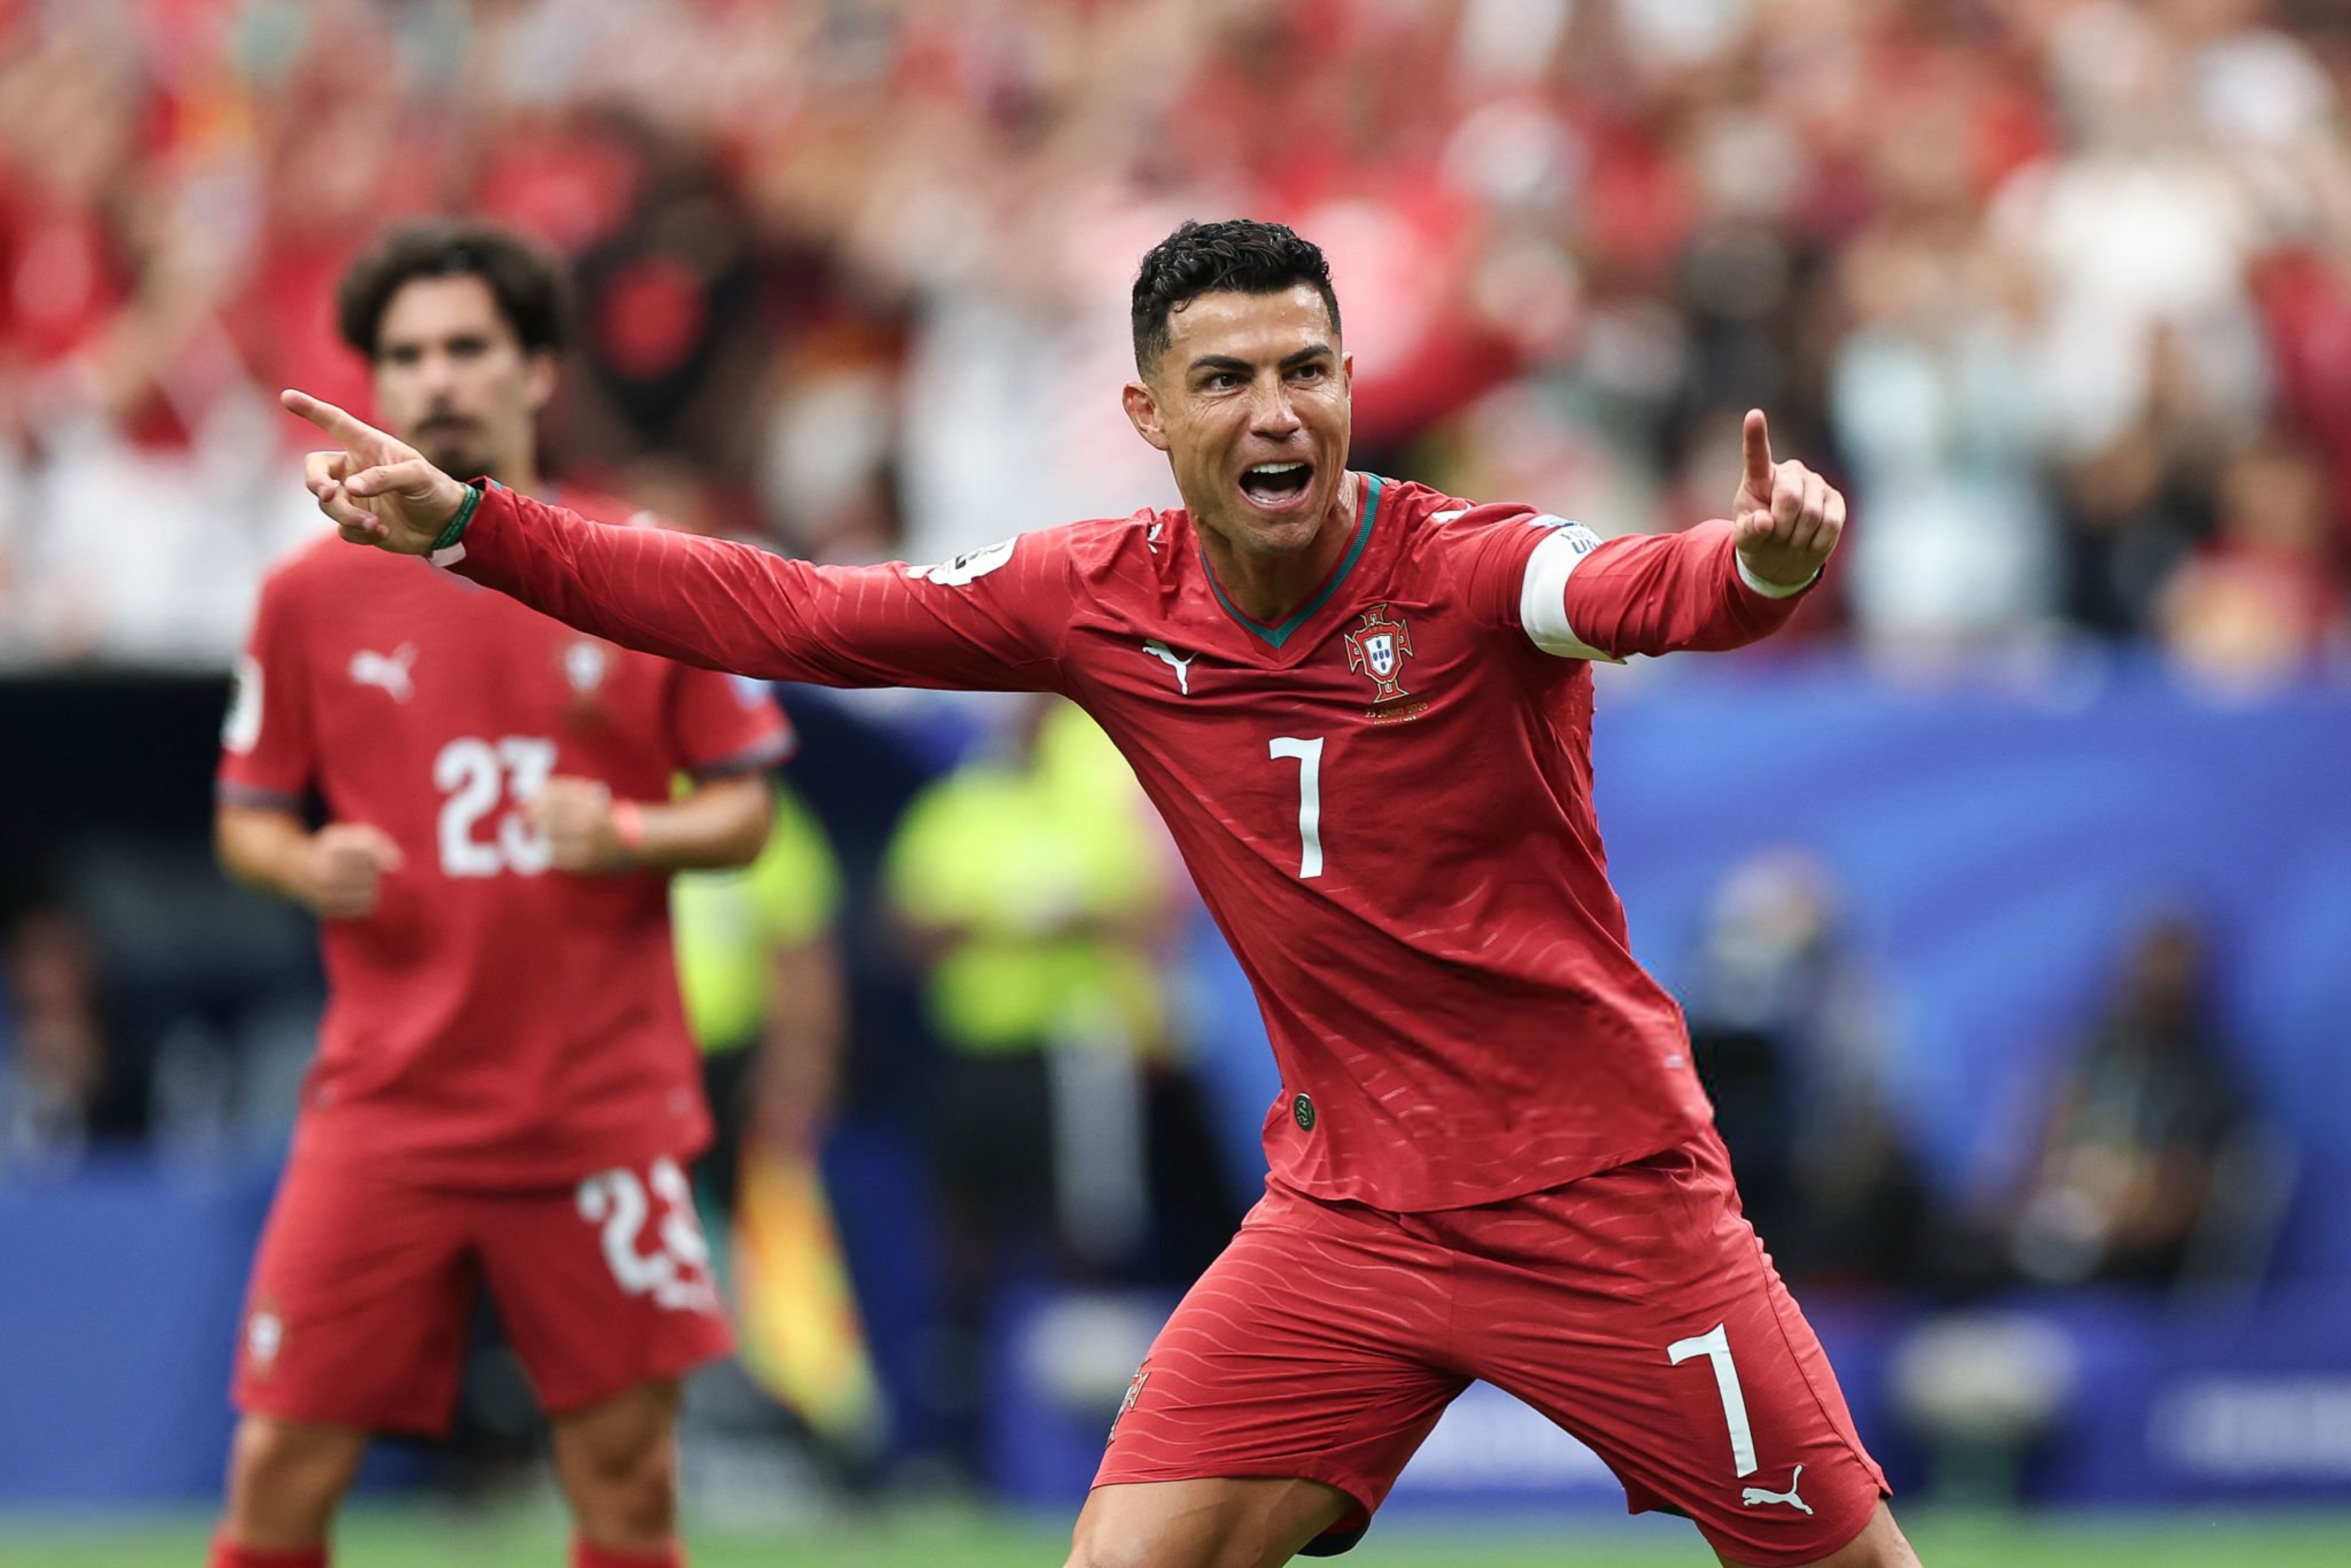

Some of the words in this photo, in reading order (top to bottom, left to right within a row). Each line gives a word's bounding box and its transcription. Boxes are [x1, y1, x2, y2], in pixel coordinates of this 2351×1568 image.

[1571, 539, 1599, 554] UN
[434, 736, 558, 876] 23
[1269, 737, 1324, 879] 7
[1667, 1323, 1757, 1478] 7
